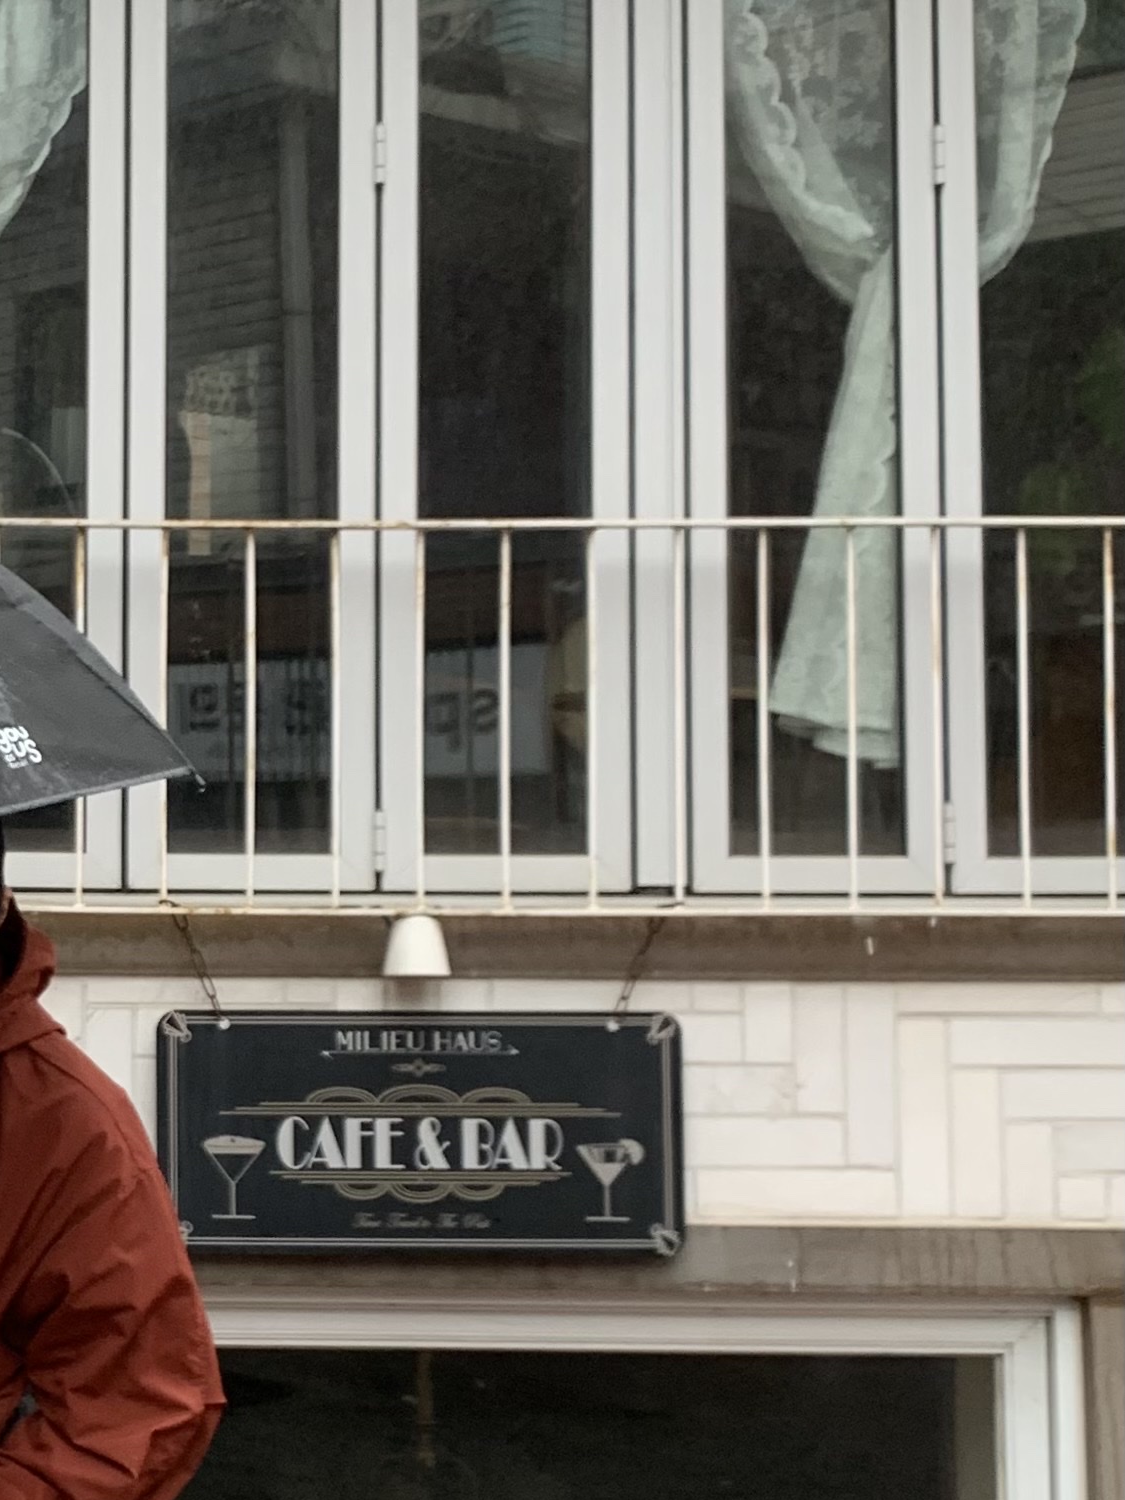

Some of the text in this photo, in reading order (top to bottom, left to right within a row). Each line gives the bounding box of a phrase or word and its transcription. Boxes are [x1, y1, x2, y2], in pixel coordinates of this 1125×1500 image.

[335, 1030, 503, 1052] MILIEU HAUS
[276, 1116, 564, 1171] CAFE & BAR
